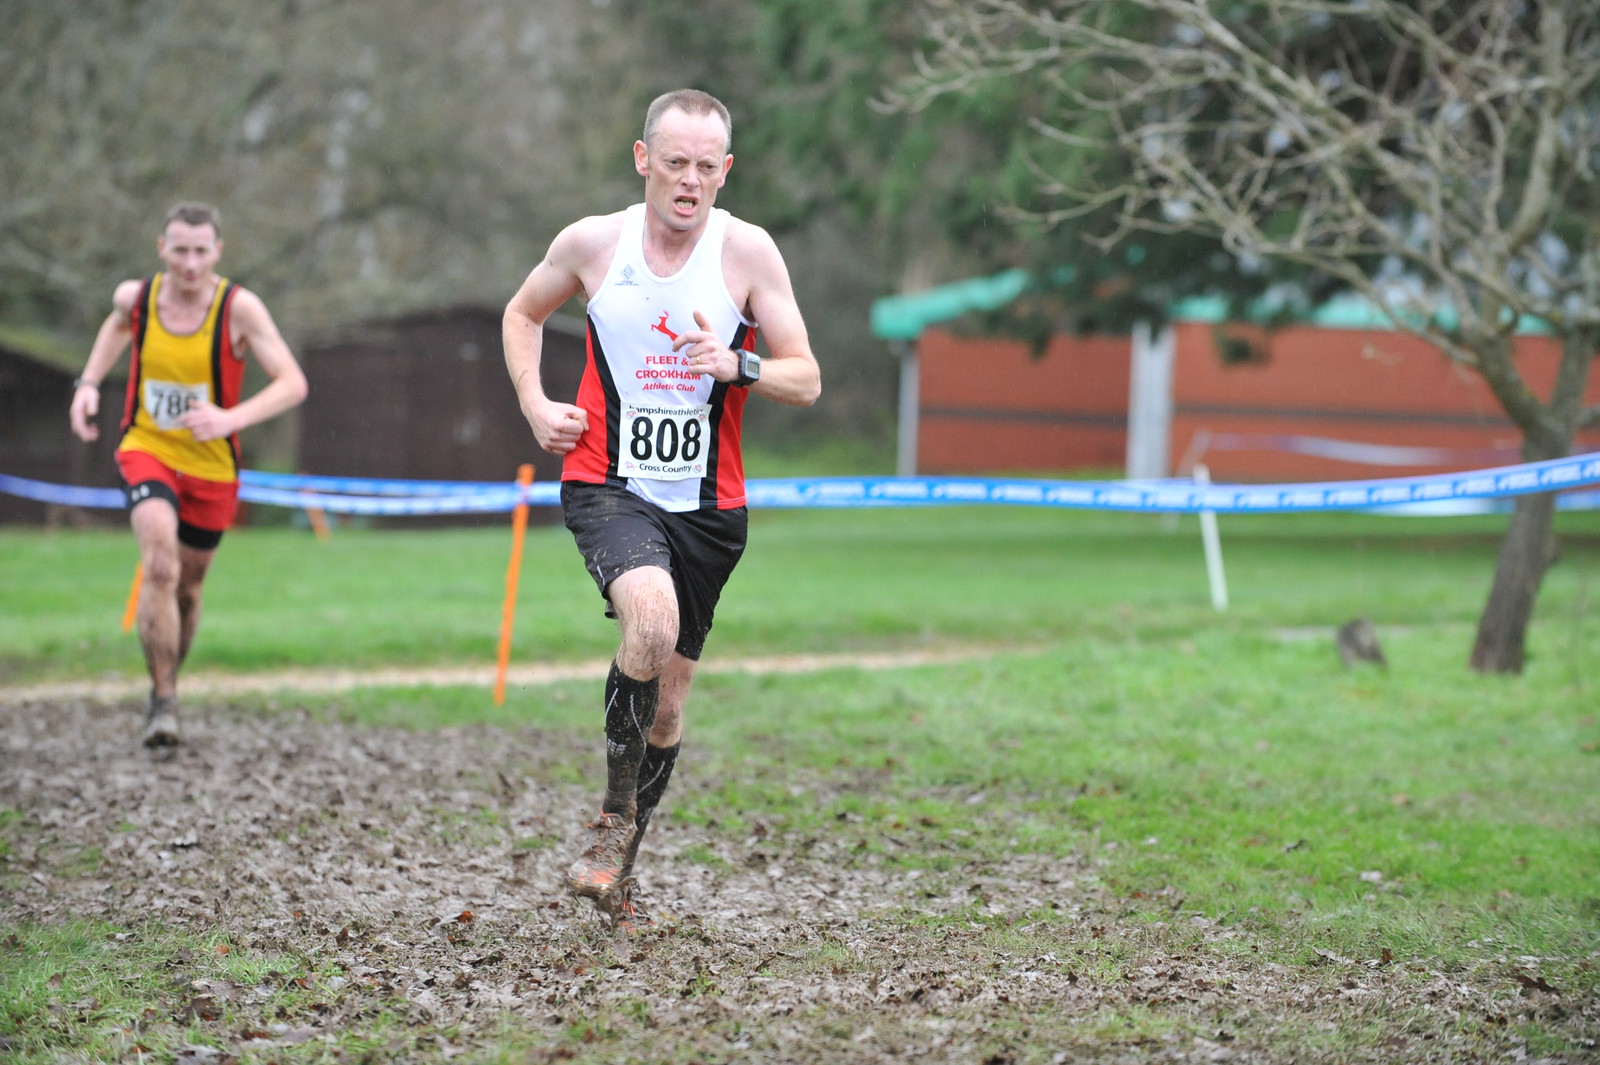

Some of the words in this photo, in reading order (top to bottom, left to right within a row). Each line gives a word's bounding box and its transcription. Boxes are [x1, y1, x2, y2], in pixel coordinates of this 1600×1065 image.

[645, 355, 679, 365] FLEET
[681, 357, 689, 366] &
[635, 369, 701, 381] CROOKHAM
[642, 382, 675, 391] Athletic
[676, 383, 696, 392] Club
[630, 416, 702, 463] 808
[639, 462, 661, 472] Cross
[662, 465, 692, 474] Country
